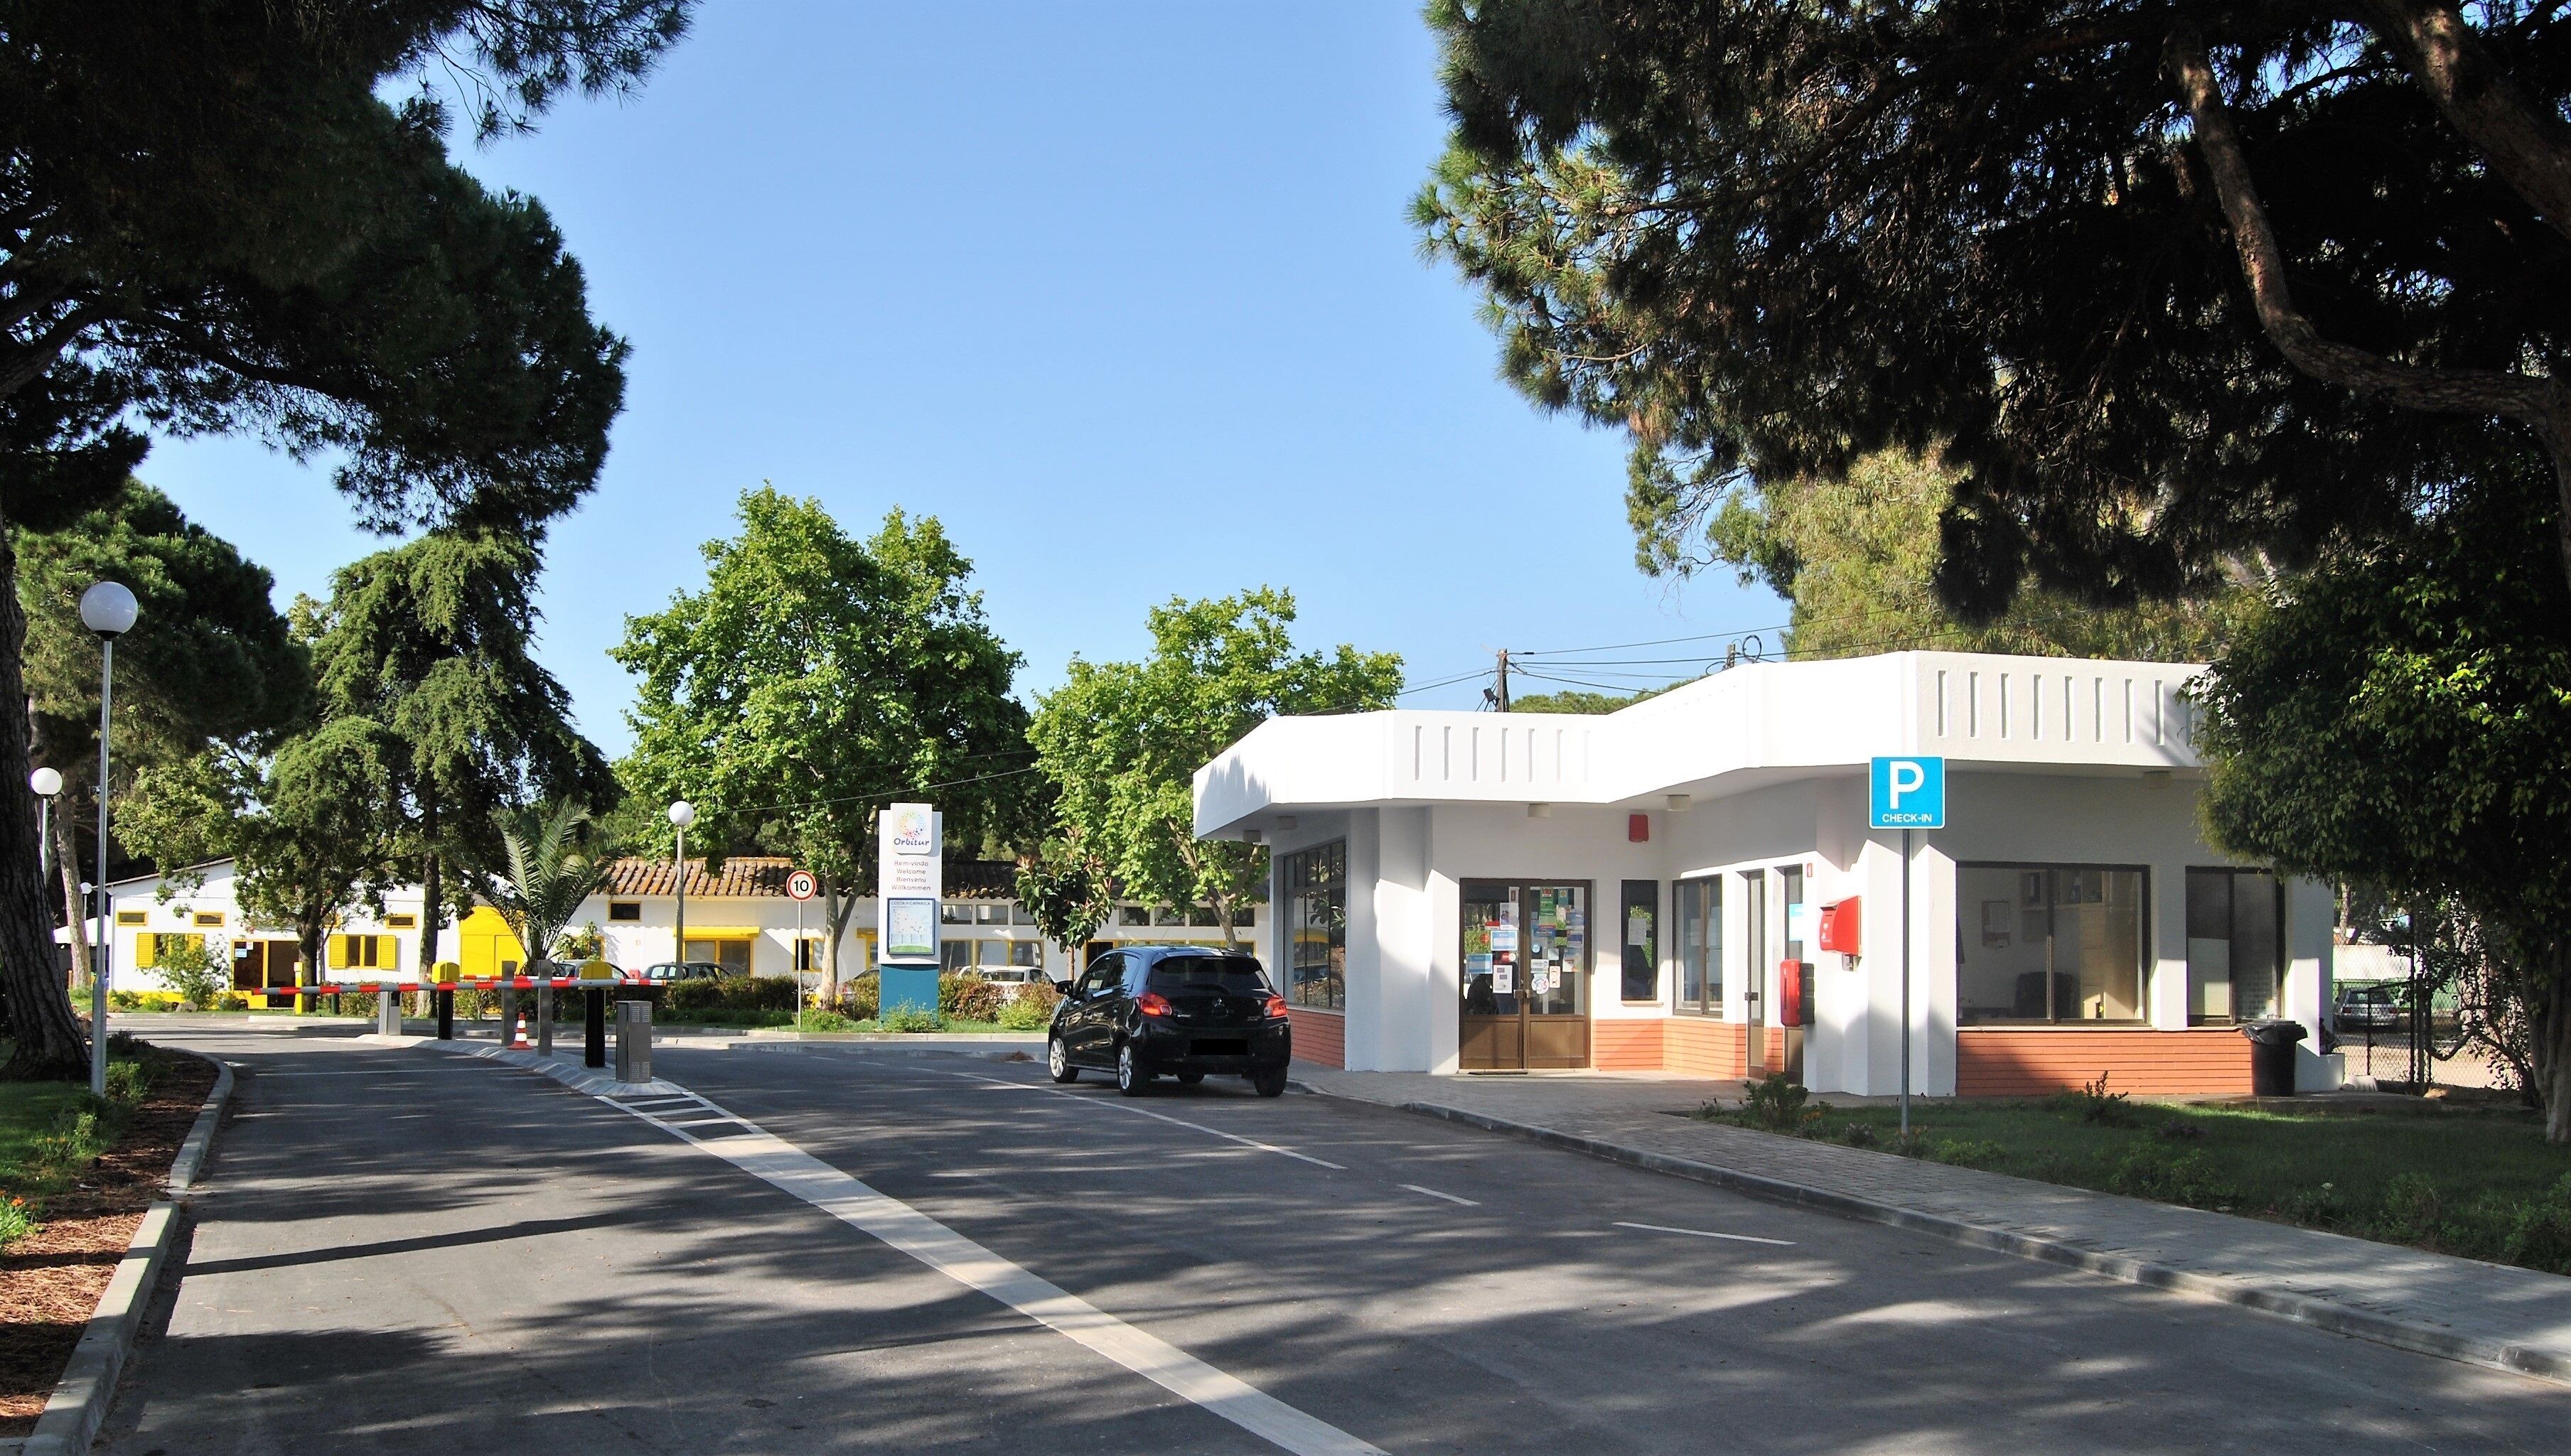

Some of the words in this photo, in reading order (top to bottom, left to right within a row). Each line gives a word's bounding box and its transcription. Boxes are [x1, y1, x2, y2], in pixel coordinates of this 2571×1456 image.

[1889, 760, 1925, 809] P
[1882, 813, 1933, 823] CHECK-IN
[794, 880, 809, 892] 10
